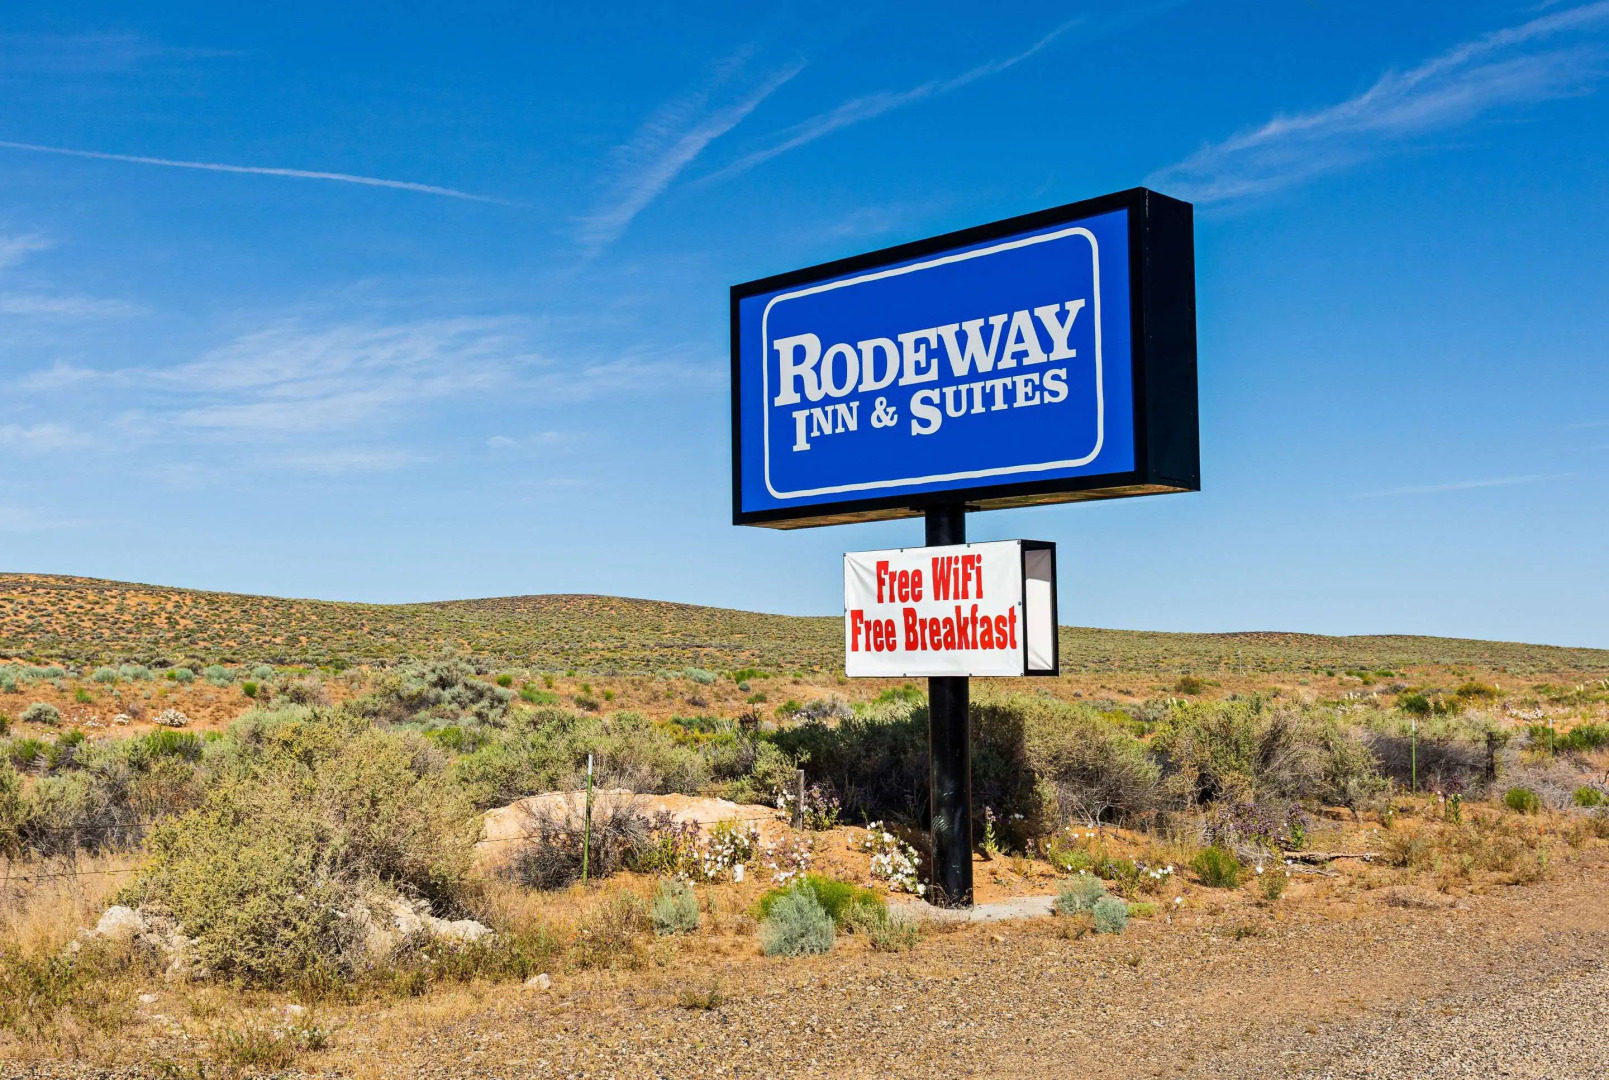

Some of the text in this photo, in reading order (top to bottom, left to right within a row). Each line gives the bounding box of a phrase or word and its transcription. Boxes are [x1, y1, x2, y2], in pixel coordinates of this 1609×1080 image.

[773, 298, 1085, 407] RODEWAY
[792, 368, 1069, 452] INN & SUITES
[876, 554, 983, 604] Free WiFi
[850, 604, 1018, 652] Free Breakfast
